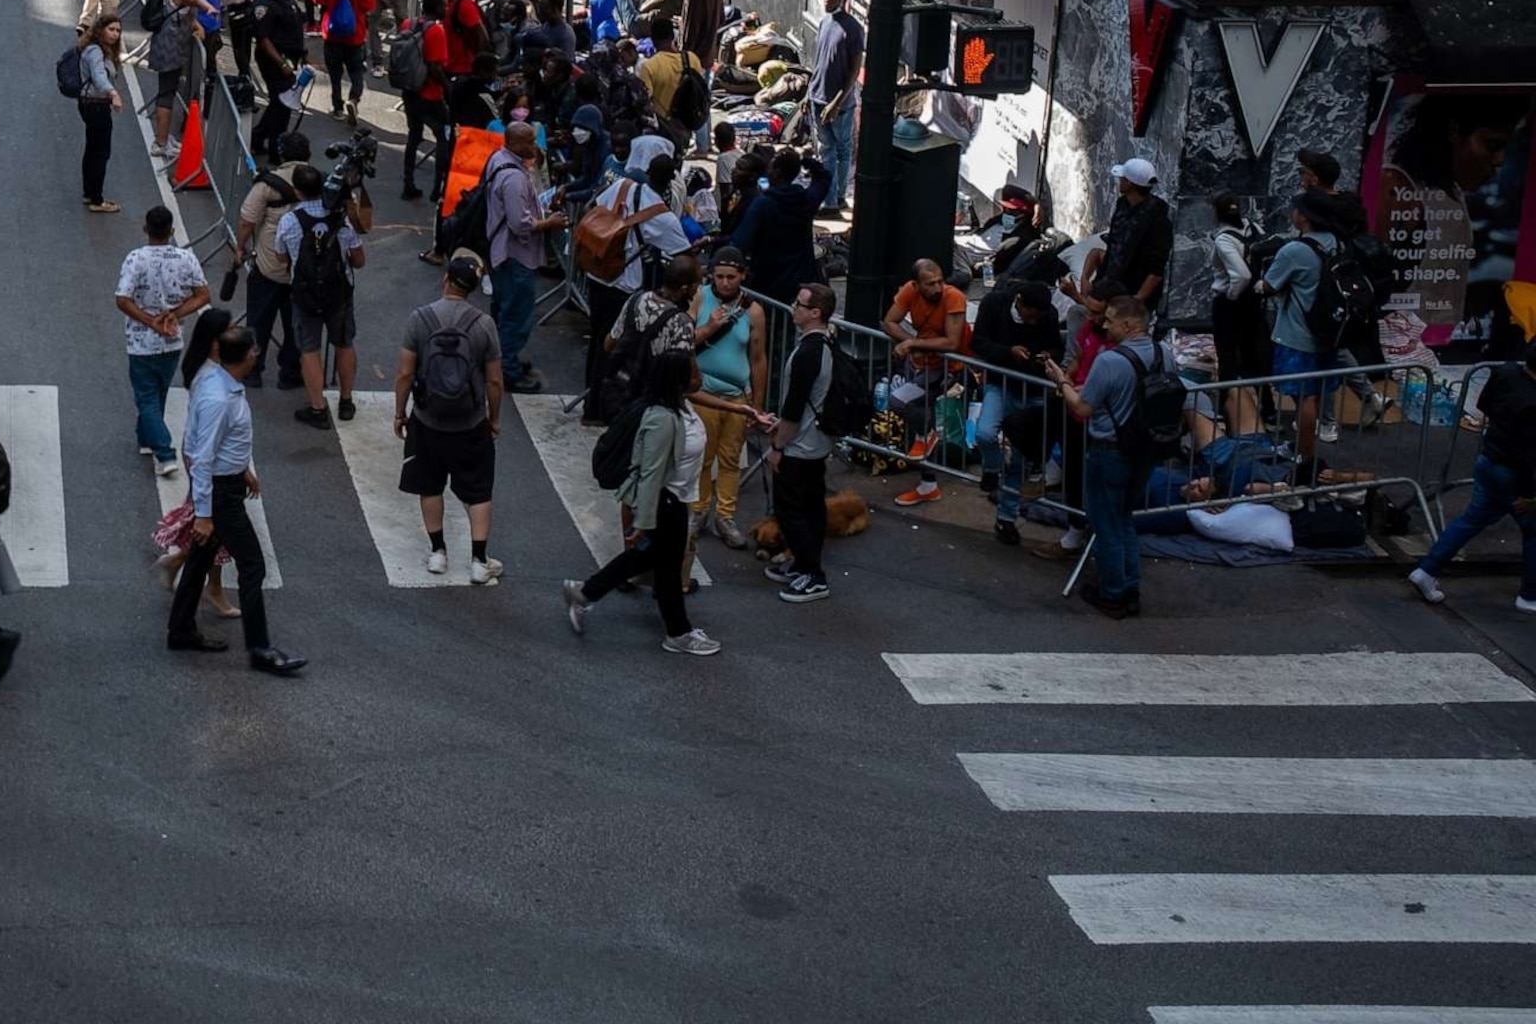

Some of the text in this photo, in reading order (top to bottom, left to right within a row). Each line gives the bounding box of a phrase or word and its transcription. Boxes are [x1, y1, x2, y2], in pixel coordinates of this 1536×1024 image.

[1393, 186, 1446, 201] You're
[1390, 206, 1464, 222] not here
[1389, 227, 1442, 245] to get
[1429, 244, 1477, 260] selfie
[1403, 265, 1461, 284] shape.
